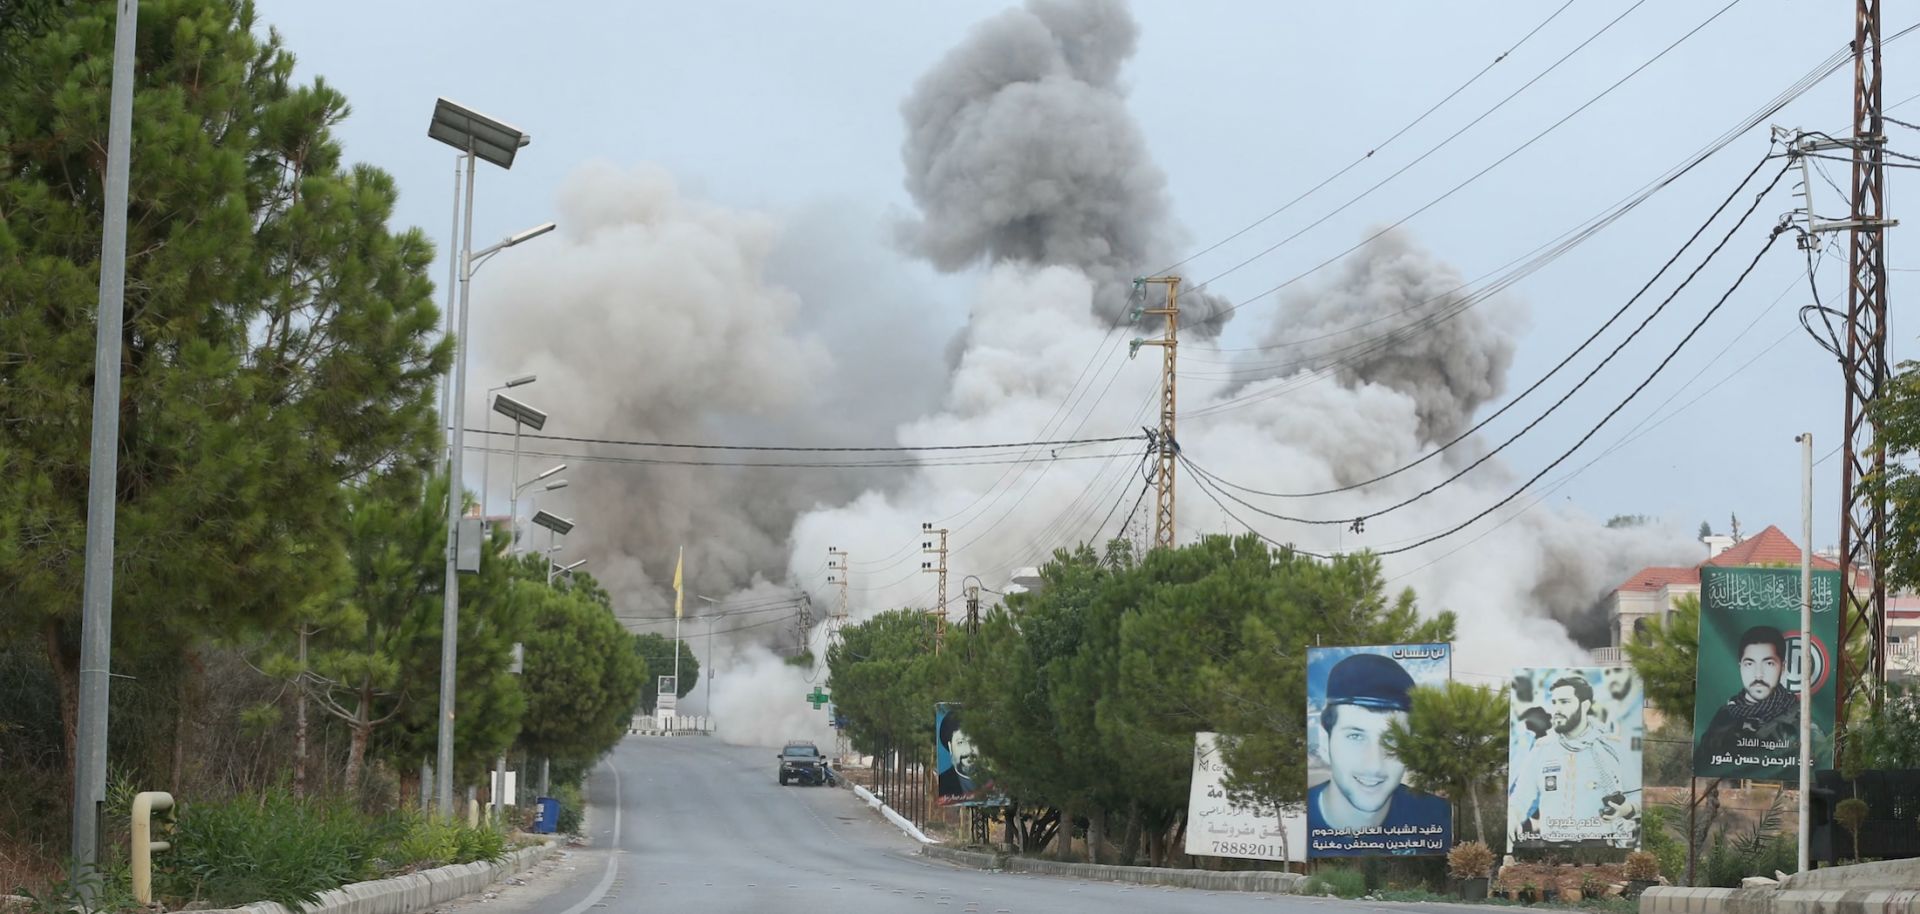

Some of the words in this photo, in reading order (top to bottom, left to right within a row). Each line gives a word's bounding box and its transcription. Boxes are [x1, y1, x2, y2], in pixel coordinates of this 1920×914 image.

[1737, 738, 1760, 747] القائد
[1761, 739, 1790, 750] الشهيد
[1710, 752, 1733, 764] شور
[1735, 754, 1760, 766] حسن
[1762, 755, 1796, 767] الرحمن
[1798, 758, 1814, 766] عد
[1312, 827, 1351, 837] المرحوم
[1352, 826, 1382, 839] الغالي
[1384, 824, 1418, 835] الشباب
[1418, 825, 1443, 834] فقيد
[1212, 841, 1283, 857] 78882011
[1312, 839, 1343, 850] مغنية
[1344, 839, 1385, 850] مصطفى
[1386, 839, 1426, 850] العابدين
[1427, 839, 1443, 849] زين
